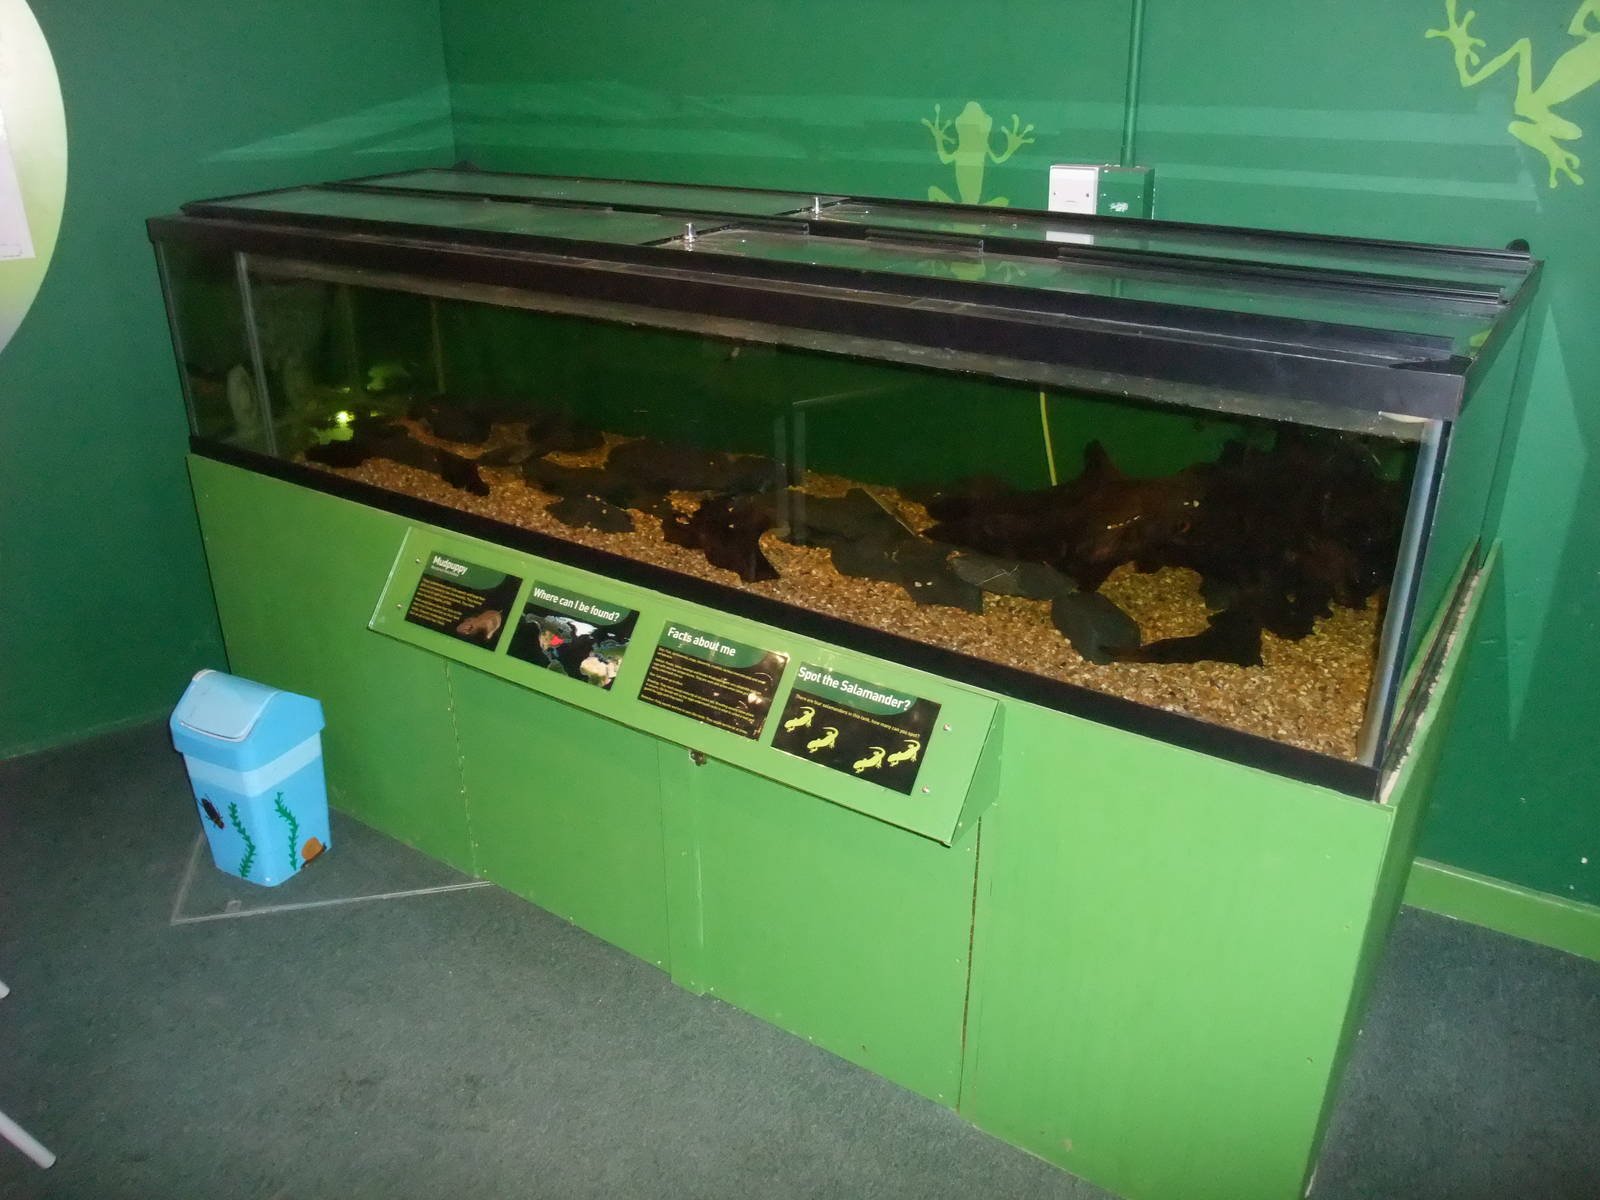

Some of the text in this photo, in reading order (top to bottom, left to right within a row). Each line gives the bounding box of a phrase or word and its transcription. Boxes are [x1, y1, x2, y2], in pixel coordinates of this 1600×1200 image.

[432, 555, 468, 576] Mudpuppy
[533, 587, 620, 622] Where can I be found?
[667, 626, 736, 657] Facts about me
[798, 666, 911, 712] Spot the Salamander?
